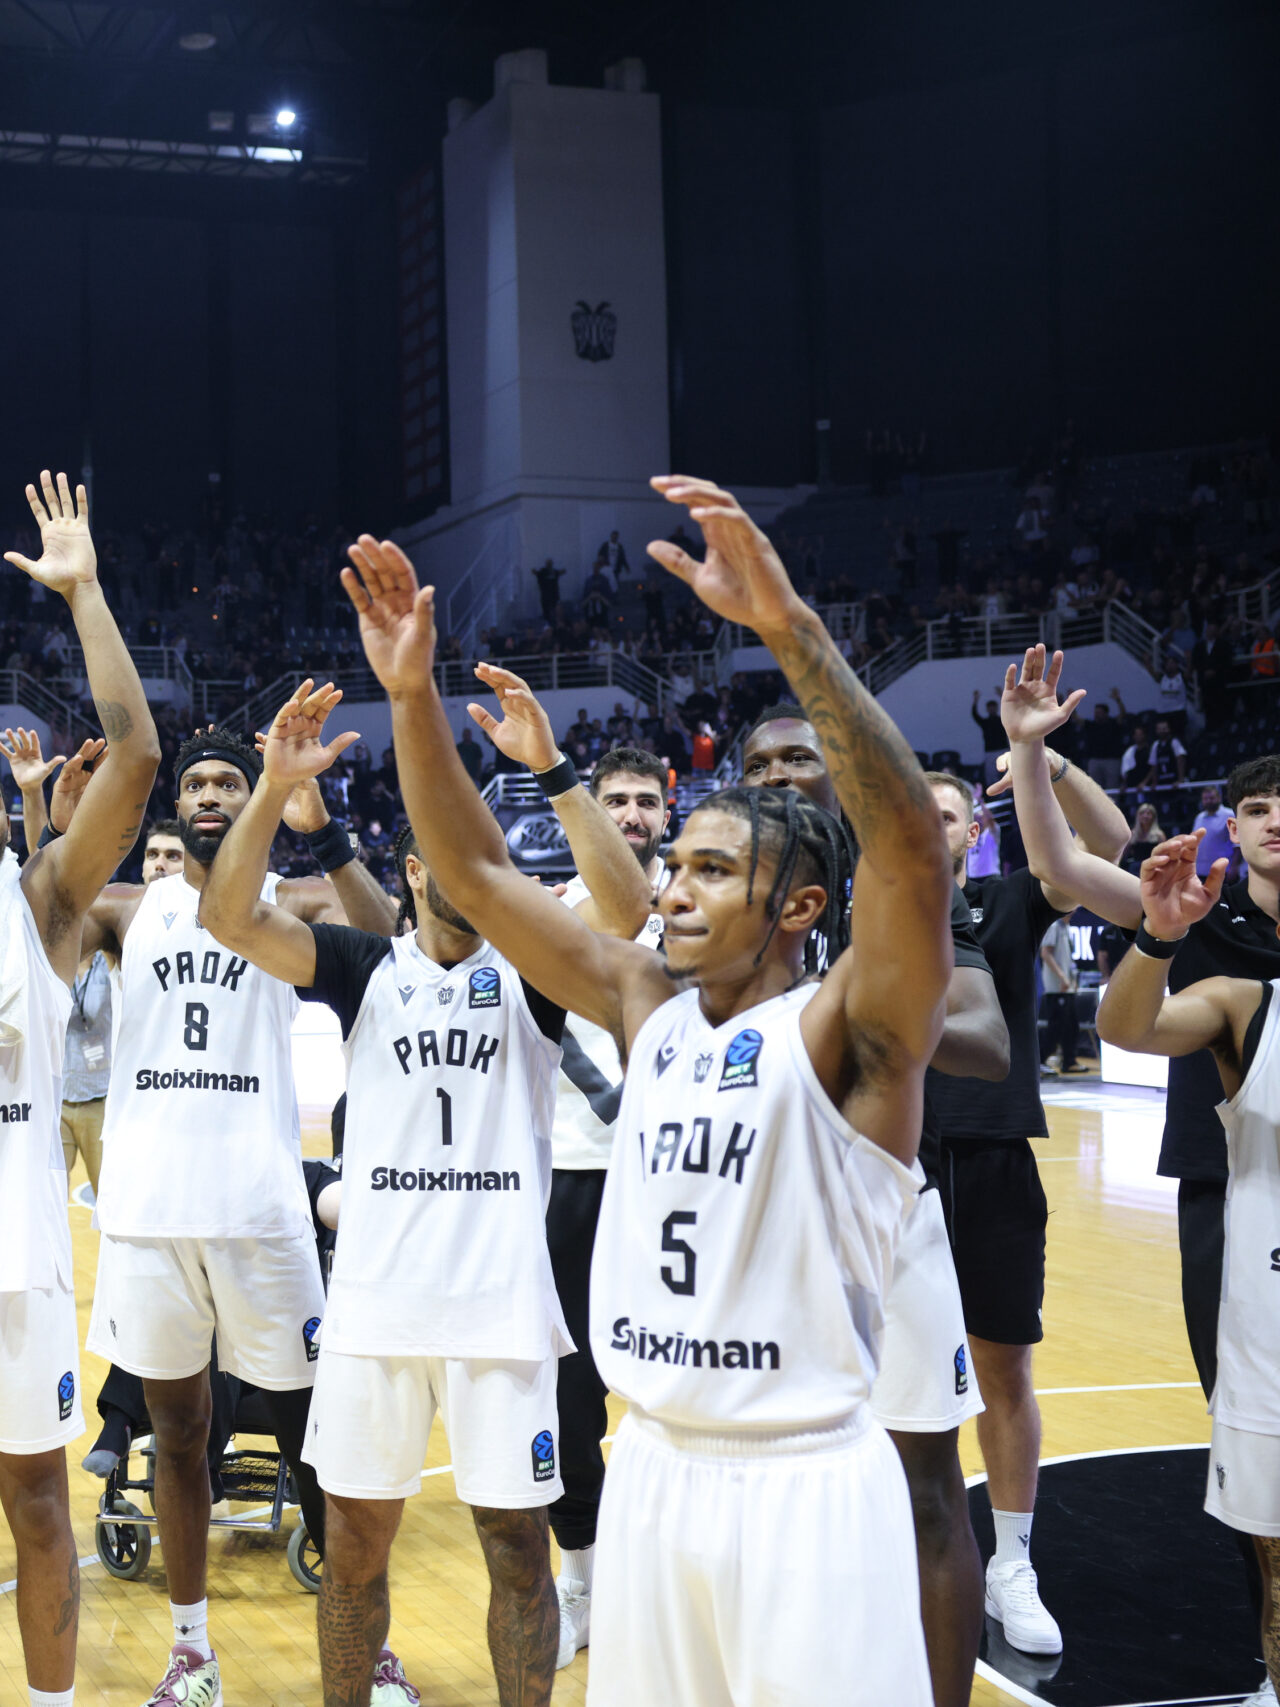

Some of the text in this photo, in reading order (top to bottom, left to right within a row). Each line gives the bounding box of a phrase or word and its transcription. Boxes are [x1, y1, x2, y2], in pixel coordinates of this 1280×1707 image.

[152, 951, 248, 992] PAOK
[471, 997, 500, 1007] EuroCup
[474, 989, 497, 1000] BKT
[183, 1002, 209, 1051] 8
[393, 1028, 500, 1075] PAOK
[136, 1069, 260, 1093] Stoiximan
[720, 1074, 755, 1088] EuroCup
[724, 1062, 752, 1079] BKT
[436, 1087, 453, 1146] 1
[371, 1166, 521, 1191] Stoiximan
[660, 1210, 697, 1297] 5
